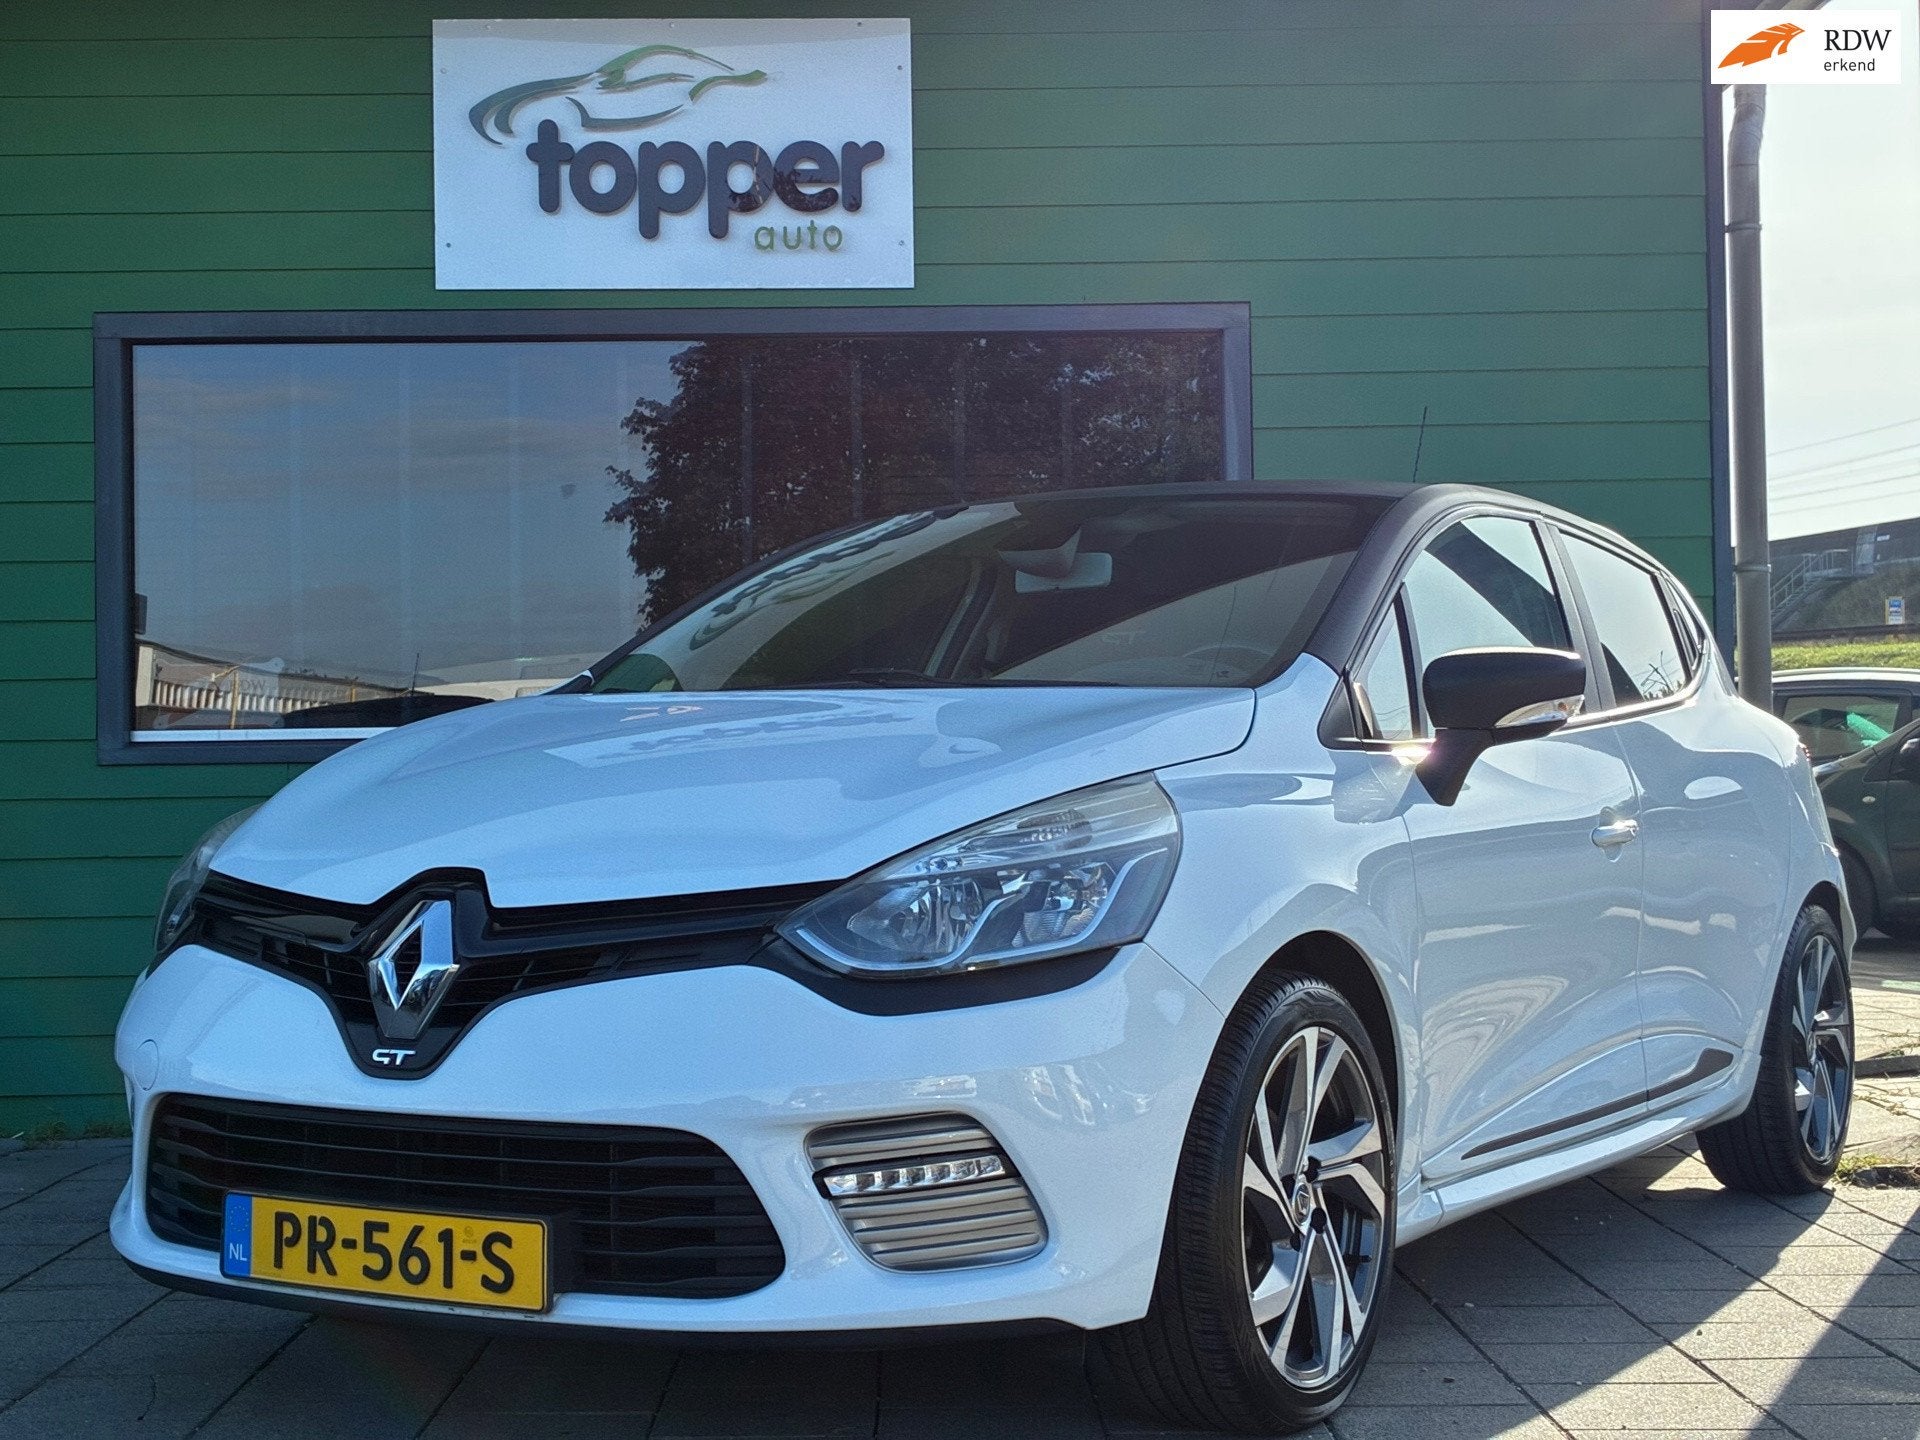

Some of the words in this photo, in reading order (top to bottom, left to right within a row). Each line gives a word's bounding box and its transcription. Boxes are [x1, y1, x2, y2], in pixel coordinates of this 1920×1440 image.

[526, 119, 886, 239] topper
[754, 220, 844, 251] auto
[372, 1048, 416, 1066] GT
[228, 1243, 248, 1262] NL
[273, 1211, 515, 1294] PR-561-S
